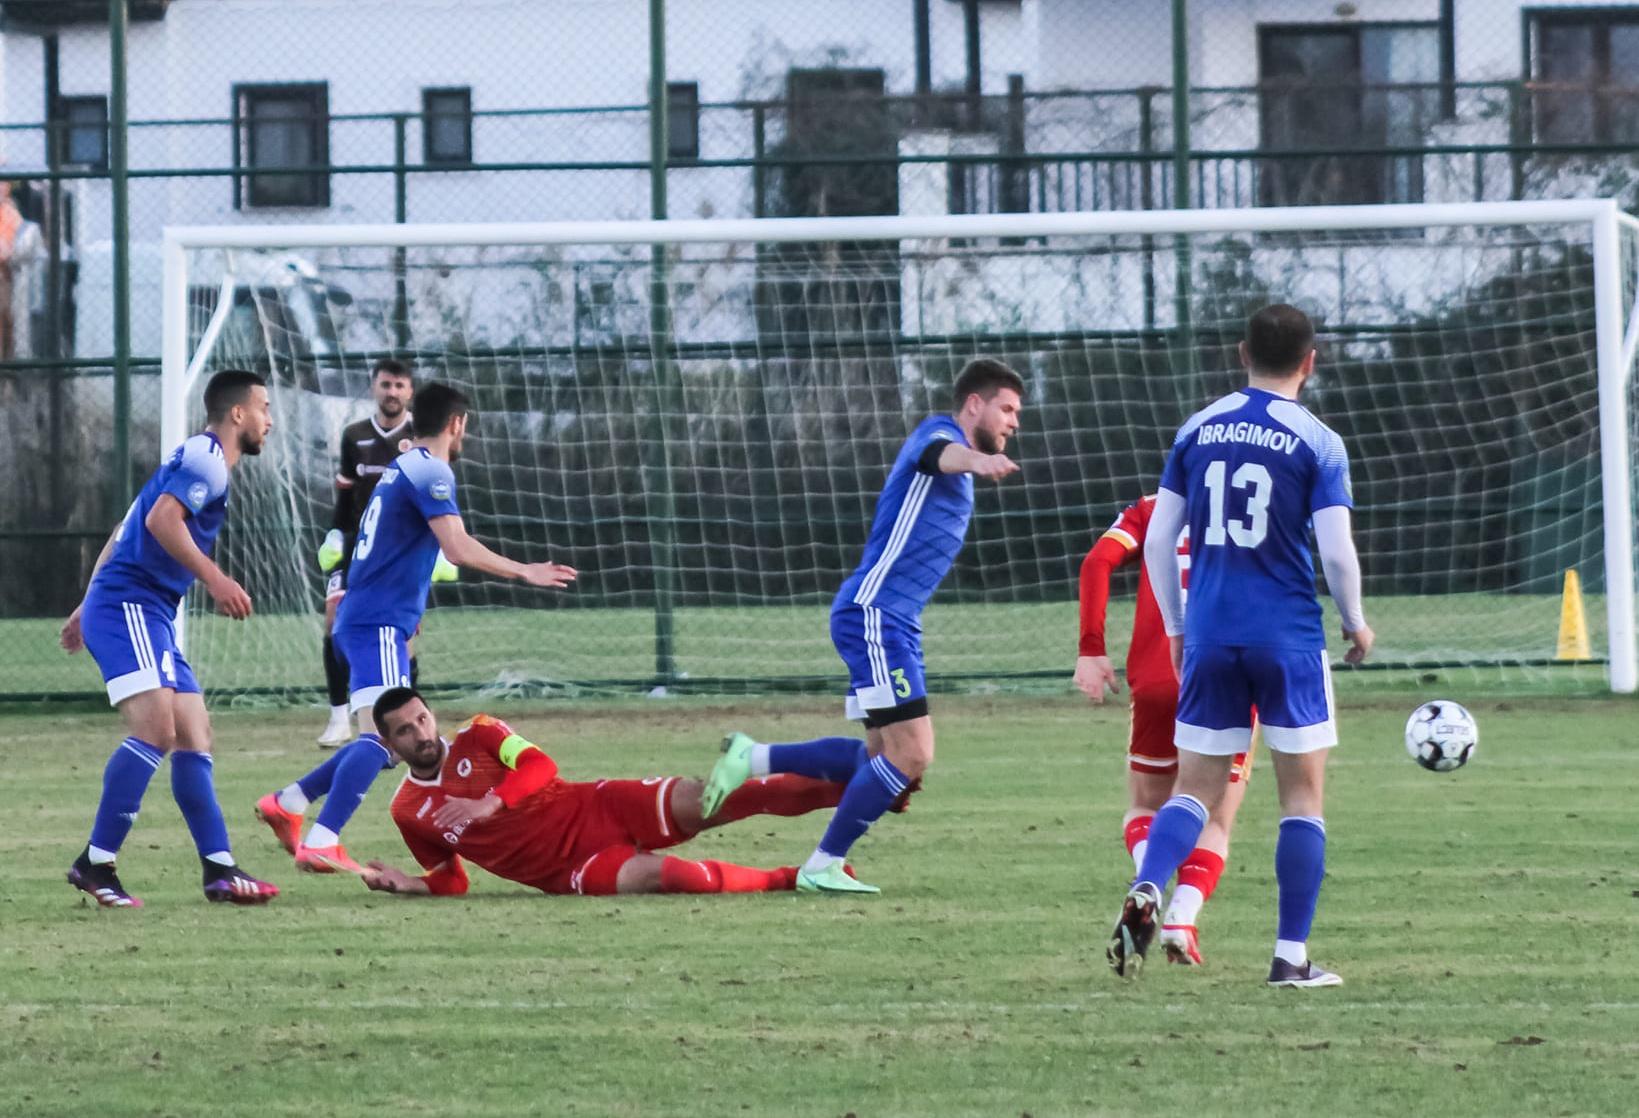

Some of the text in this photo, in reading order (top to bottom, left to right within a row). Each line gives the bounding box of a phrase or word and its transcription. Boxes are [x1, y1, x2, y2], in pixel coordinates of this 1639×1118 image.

[1197, 421, 1300, 455] IBRAGIMOV
[1204, 460, 1273, 548] 13
[890, 668, 911, 698] 3
